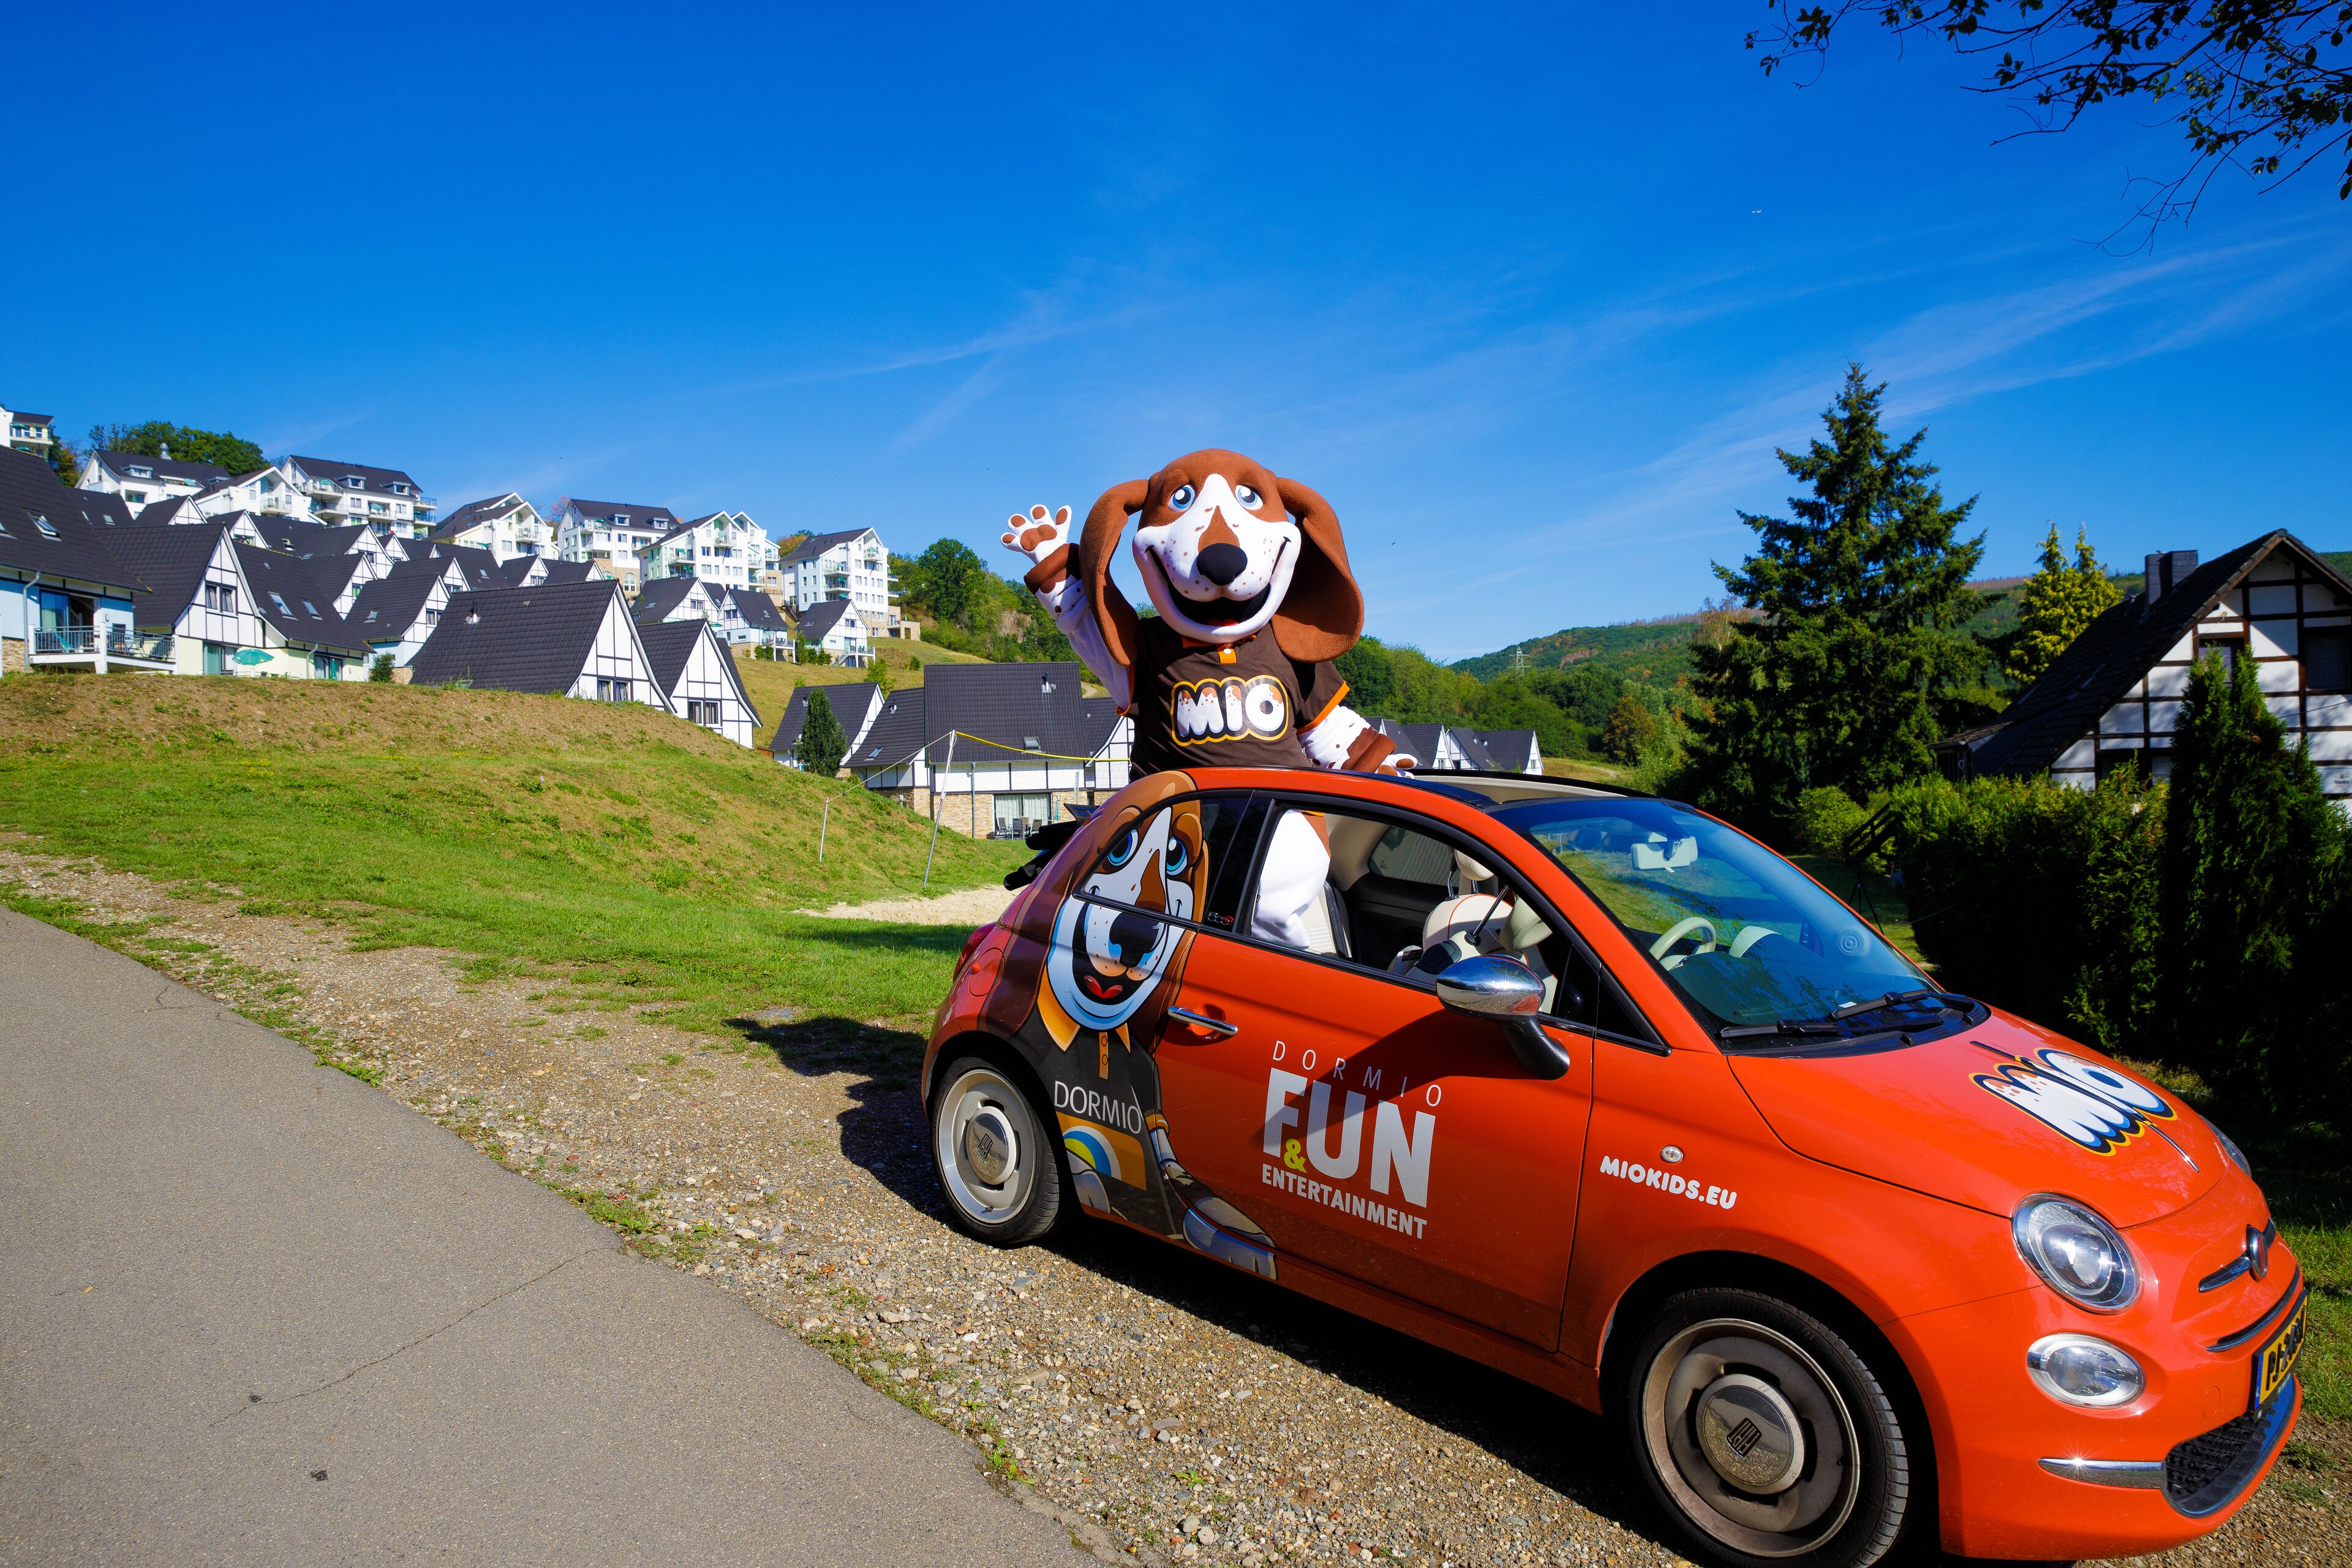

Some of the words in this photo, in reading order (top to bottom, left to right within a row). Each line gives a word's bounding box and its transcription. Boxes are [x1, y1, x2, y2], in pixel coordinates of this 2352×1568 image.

[1175, 681, 1285, 739] MIO
[1272, 1040, 1442, 1107] DORMIO
[1977, 1050, 2166, 1150] MIO
[1054, 1080, 1142, 1134] DORMIO
[1262, 1067, 1436, 1208] FUN
[1284, 1138, 1307, 1173] &
[1599, 1155, 1737, 1209] MIOKIDS.EU
[1262, 1163, 1428, 1240] ENTERTAINMENT
